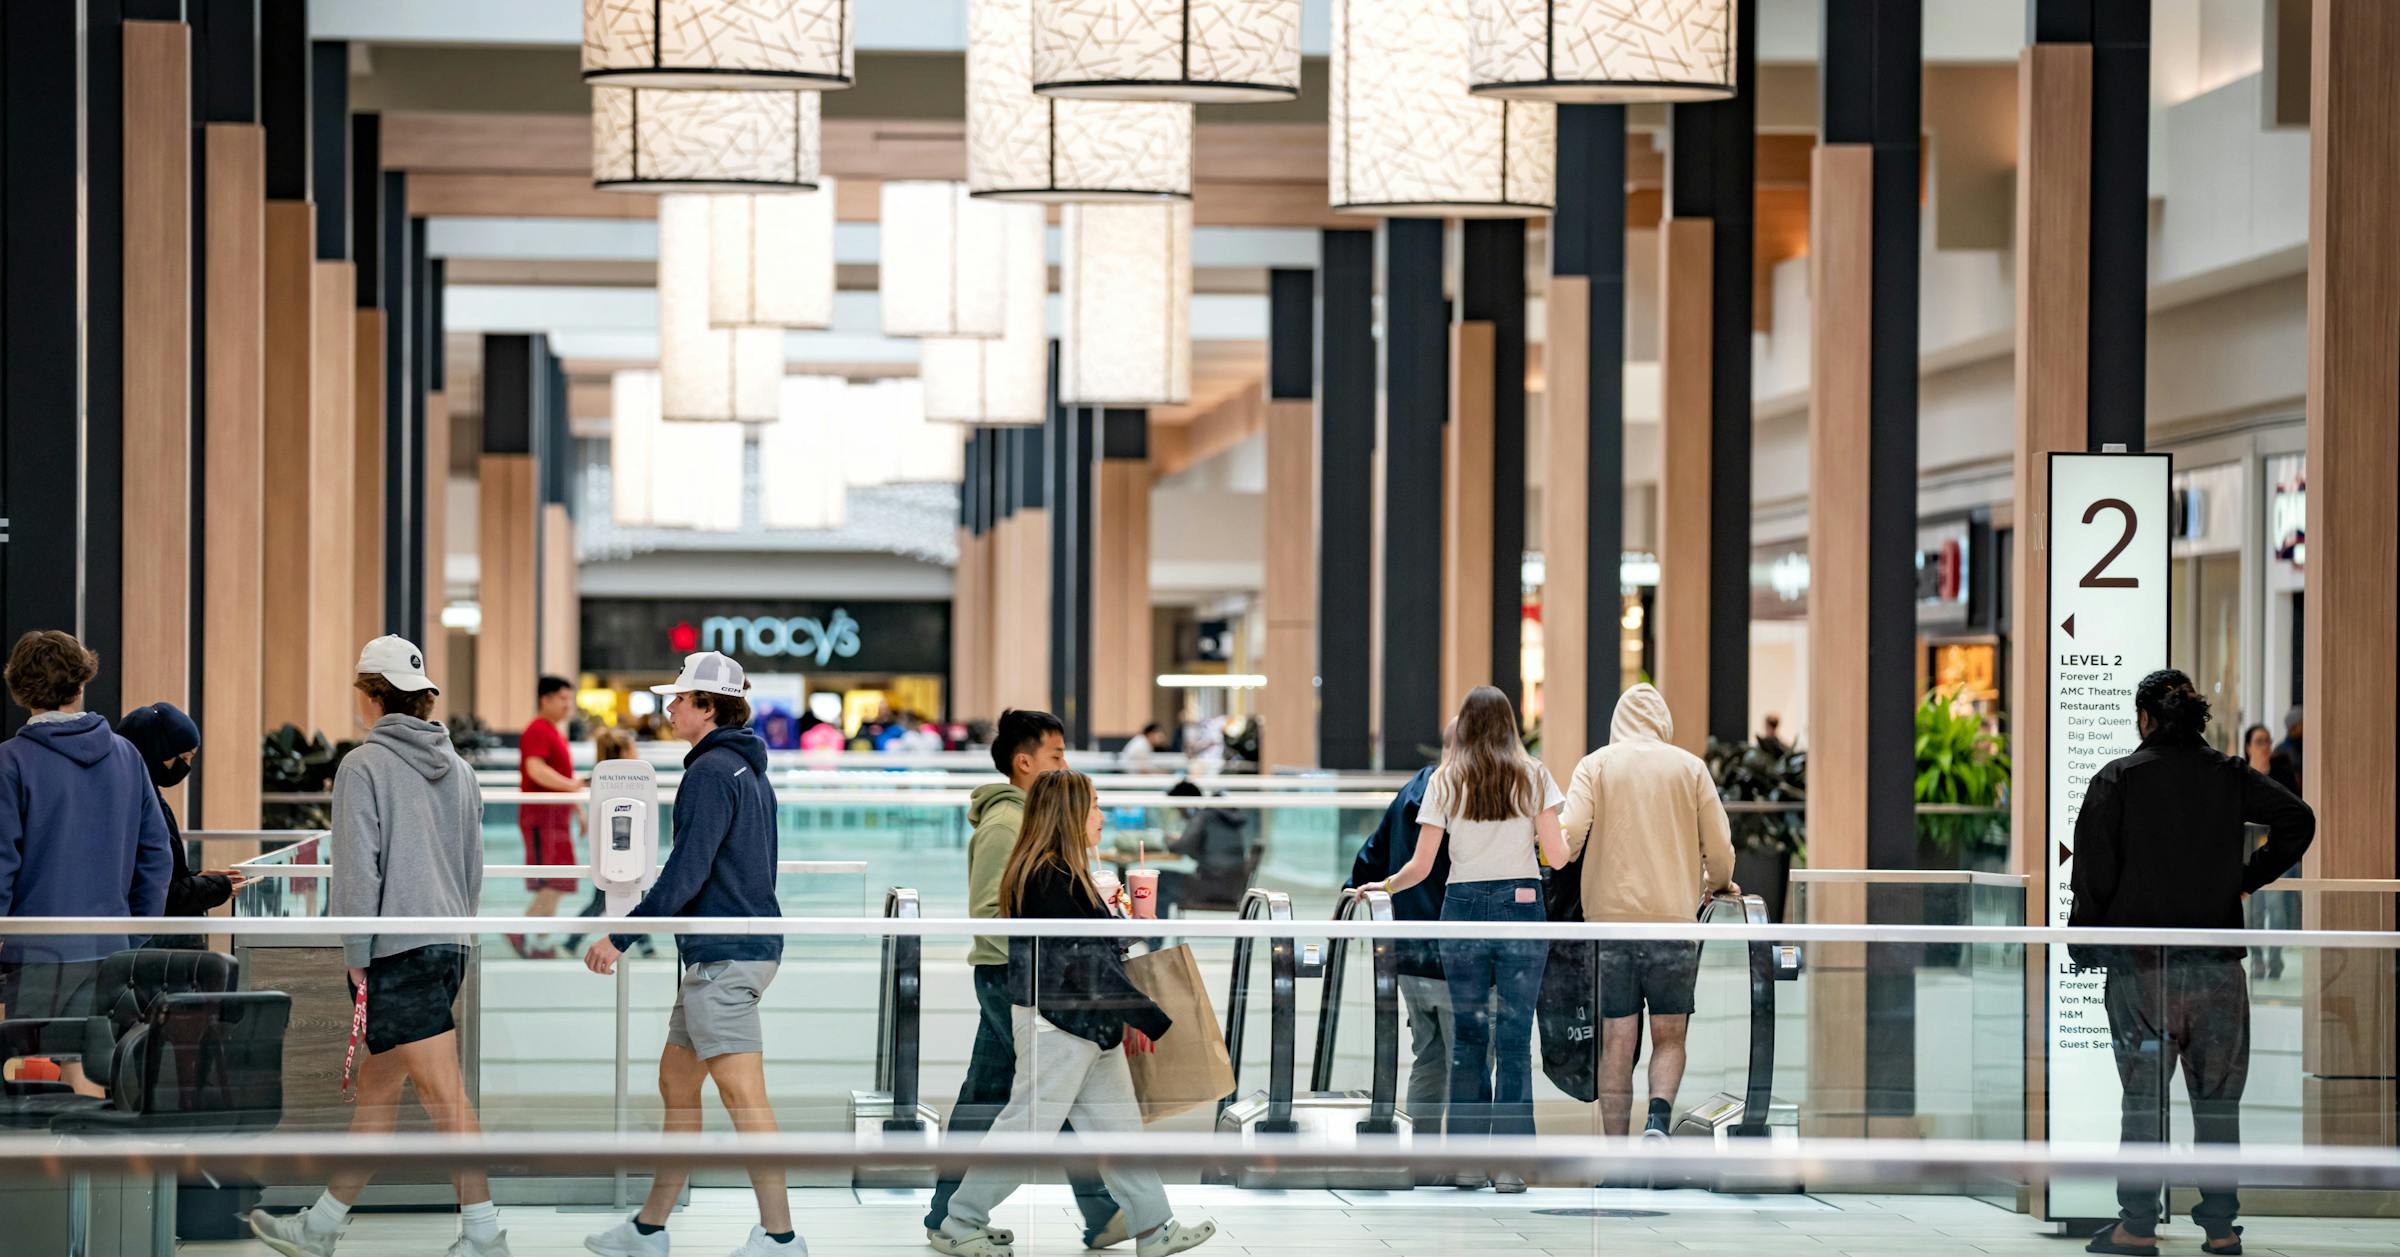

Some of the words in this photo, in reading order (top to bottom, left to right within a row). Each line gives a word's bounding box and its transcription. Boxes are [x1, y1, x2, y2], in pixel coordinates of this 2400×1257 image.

[2079, 498, 2138, 587] 2
[702, 608, 861, 667] macy's
[2061, 655, 2108, 666] LEVEL
[2114, 655, 2122, 666] 2
[2060, 672, 2099, 681] Forever
[2102, 672, 2113, 681] 21
[2060, 687, 2084, 696] AMC
[2088, 687, 2132, 696] Theatres
[2060, 702, 2120, 711] Restaurants
[2068, 716, 2095, 727] Dairy
[2098, 716, 2132, 726] Queen
[2068, 731, 2085, 742] Big
[2088, 731, 2113, 741] Bowl
[2068, 746, 2094, 757] Maya
[2097, 746, 2134, 756] Cuisine
[2068, 761, 2097, 770] Crave
[2068, 775, 2092, 786] Chip
[2060, 981, 2098, 989] Forever
[2060, 996, 2079, 1004] Von
[2082, 996, 2105, 1004] Mau
[2060, 1010, 2083, 1019] H&M
[2060, 1040, 2089, 1049] Guest
[2093, 1040, 2114, 1049] Serv
